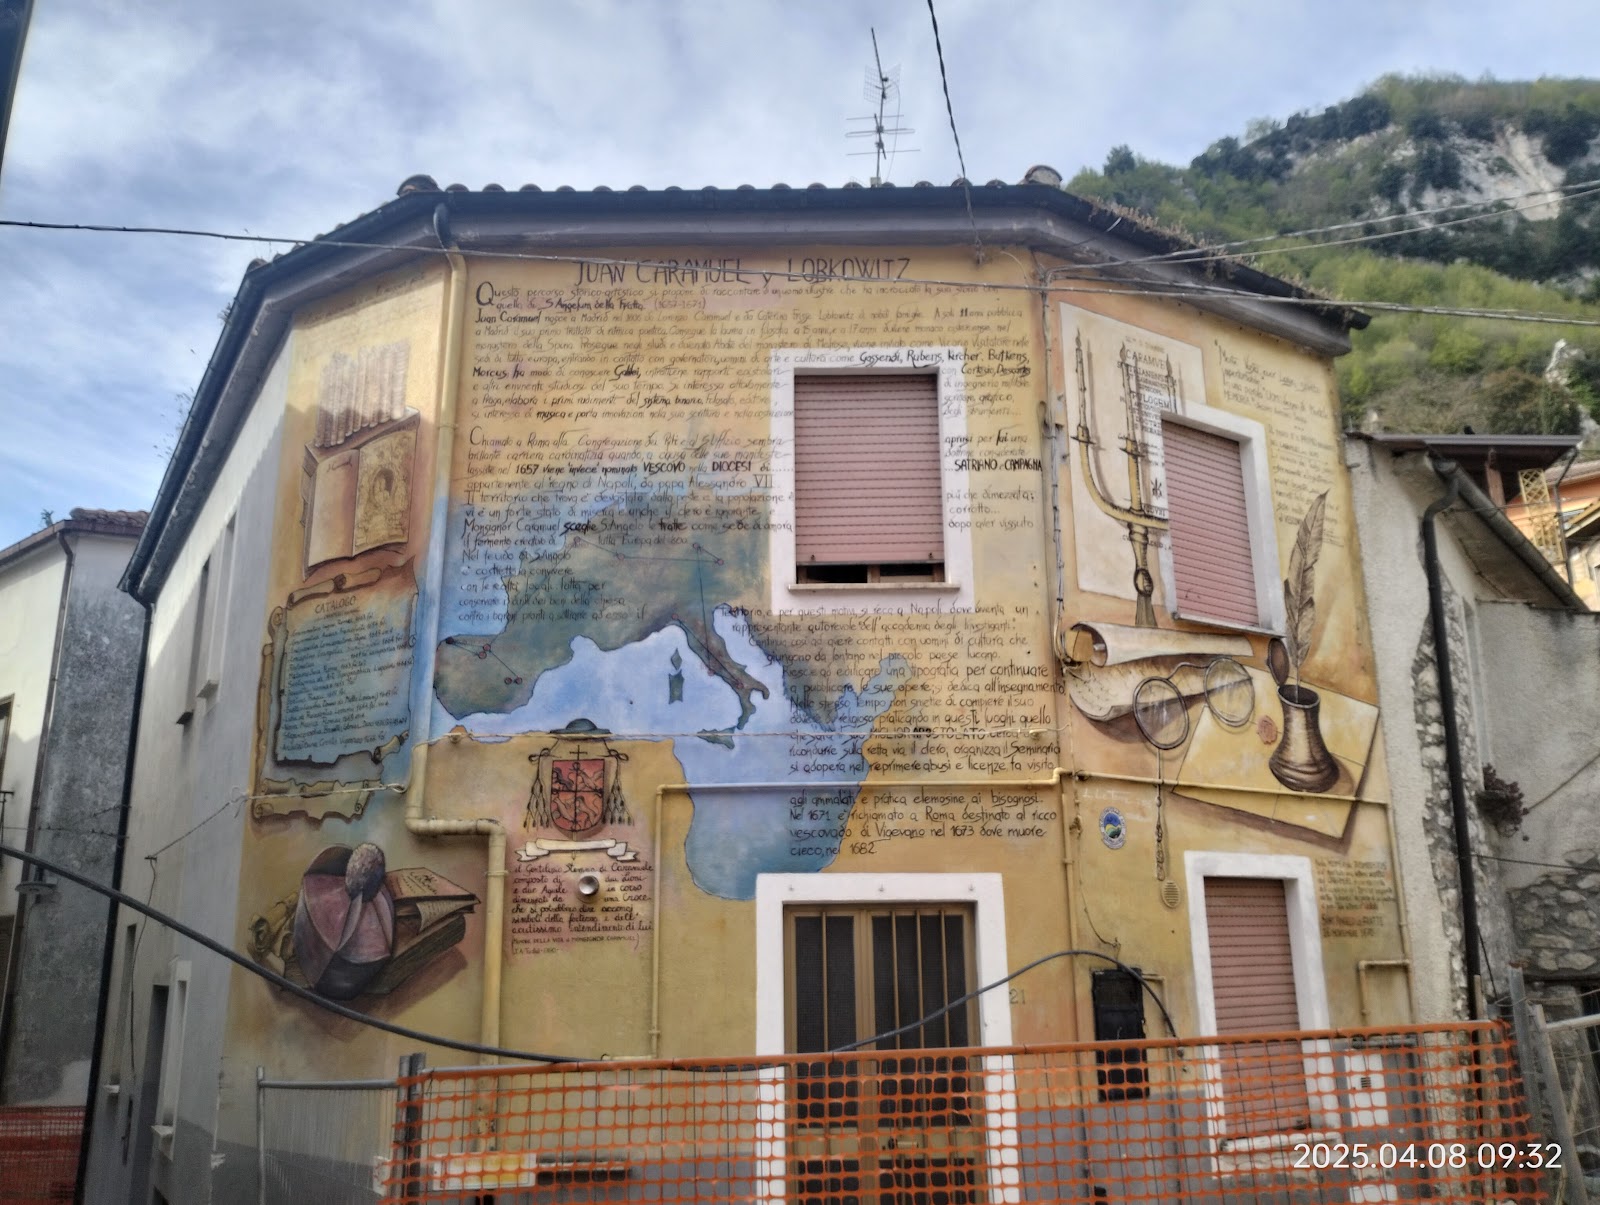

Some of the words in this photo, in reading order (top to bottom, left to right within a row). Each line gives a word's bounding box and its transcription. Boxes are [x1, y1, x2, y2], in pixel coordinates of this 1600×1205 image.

[572, 259, 627, 287] JUAN
[636, 258, 752, 287] CARAMUEL
[787, 258, 911, 284] LOBKOWITZ
[475, 281, 521, 306] Questo
[527, 289, 564, 301] percorso
[662, 289, 694, 301] propone
[713, 288, 761, 297] raccontare
[475, 308, 496, 323] Juan
[499, 310, 542, 324] Caramuel
[581, 312, 608, 323] Madrid
[694, 310, 732, 321] Caramuel
[987, 307, 1023, 318] pubblica
[484, 324, 509, 336] Madrid
[669, 325, 706, 339] Consegue
[613, 352, 644, 364] contatto
[907, 349, 944, 369] Rubens,
[530, 368, 552, 377] modo
[537, 410, 565, 423] musica
[575, 409, 598, 422] porta
[470, 426, 513, 447] Chiamato
[527, 432, 550, 448] Roma
[577, 433, 642, 450] Congregazione
[507, 450, 544, 461] carriera
[659, 451, 685, 462] causa
[515, 463, 540, 474] 1657
[643, 461, 686, 475] VESCOVO
[712, 461, 751, 473] DIOCESI
[467, 478, 531, 493] appartenente
[658, 480, 684, 490] papa
[689, 475, 747, 490] Alessandro
[480, 493, 531, 504] territorio
[531, 492, 550, 503] che
[555, 493, 577, 507] trova
[728, 493, 785, 506] popolazione
[503, 502, 531, 523] forte
[628, 507, 659, 519] anche
[463, 518, 511, 535] Monsignor
[516, 517, 560, 531] Caramuel
[948, 519, 972, 532] dopo
[1000, 516, 1033, 531] vissuto
[314, 595, 357, 614] CATALOGO
[799, 606, 826, 620] questi
[910, 603, 942, 620] Napoli
[949, 601, 971, 614] dove
[732, 623, 801, 637] rappresentante
[808, 618, 857, 634] autorevole
[857, 635, 894, 647] contatti
[898, 637, 916, 645] con
[920, 637, 949, 648] uomini
[968, 633, 1003, 648] cultura
[1009, 633, 1028, 645] che
[833, 651, 865, 663] lontano
[888, 648, 923, 666] piccolo
[929, 651, 958, 663] paese
[887, 668, 905, 678] una
[911, 660, 959, 679] tipografia
[966, 665, 987, 681] per
[990, 659, 1049, 677] continuare
[871, 683, 893, 695] sue
[948, 677, 979, 692] dedica
[856, 695, 886, 711] tempo
[891, 698, 907, 707] non
[910, 696, 942, 710] smette
[959, 695, 1003, 711] compiere
[1014, 696, 1034, 707] suo
[879, 708, 929, 725] praticando
[945, 708, 980, 728] questi
[985, 708, 1014, 728] luoghi
[1020, 704, 1051, 725] quello
[789, 743, 837, 757] ricondurre
[867, 743, 887, 757] retta
[892, 744, 905, 755] via
[920, 741, 949, 757] clero,
[953, 744, 1001, 758] organizza
[1006, 741, 1061, 758] Seminario
[803, 760, 846, 776] adopera
[849, 759, 864, 775] nel
[868, 760, 921, 776] reprimere
[923, 759, 951, 773] abusi
[968, 755, 1006, 775] licenze
[1027, 757, 1054, 772] visita
[790, 788, 807, 808] agli
[811, 788, 855, 805] ammalati
[874, 793, 907, 808] pratica
[913, 786, 965, 806] elemosine
[990, 788, 1043, 808] bisognosi.
[789, 808, 804, 821] Nel
[808, 810, 830, 821] 1671
[851, 807, 904, 822] richiamato
[925, 806, 955, 823] Roma
[962, 804, 1010, 822] destinato
[1016, 805, 1025, 821] al
[1032, 809, 1057, 821] ricco
[789, 823, 852, 840] vescovado
[860, 823, 870, 837] di
[875, 822, 925, 839] Vigevano
[931, 822, 945, 837] nel
[950, 825, 974, 837] 1673
[980, 823, 1002, 837] dove
[1008, 827, 1047, 838] muore
[849, 841, 878, 855] 1682
[512, 924, 562, 934] acutissimo
[1009, 988, 1026, 1006] 21
